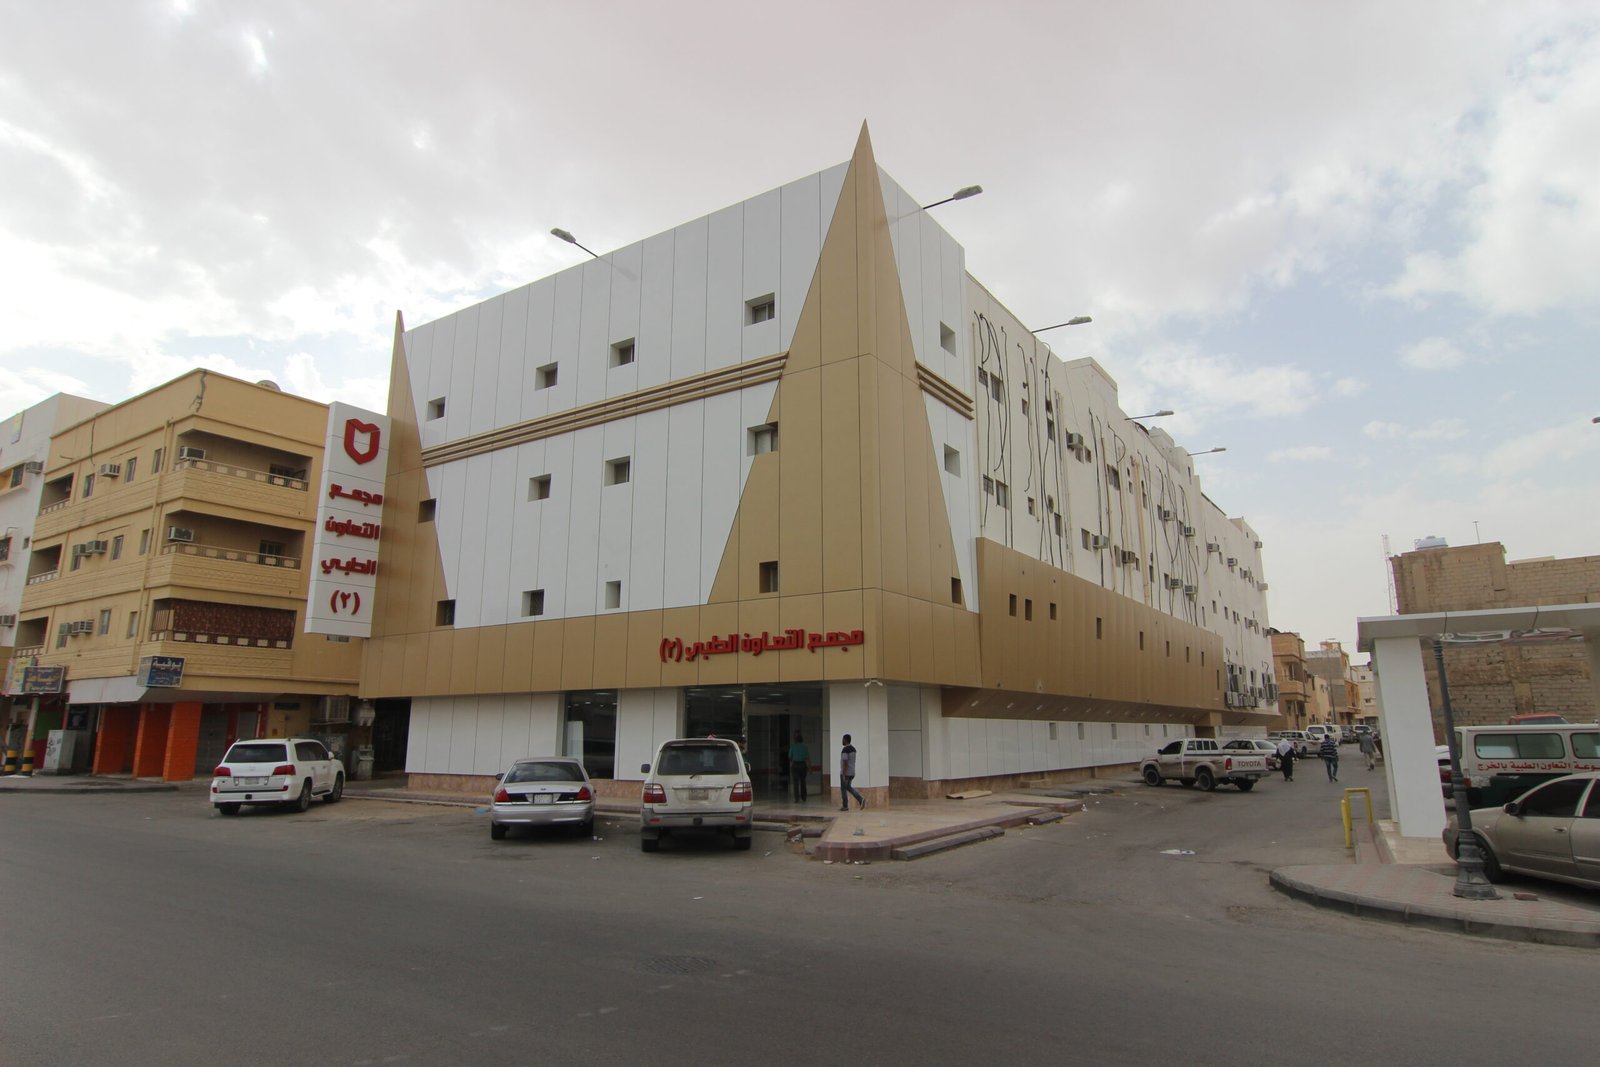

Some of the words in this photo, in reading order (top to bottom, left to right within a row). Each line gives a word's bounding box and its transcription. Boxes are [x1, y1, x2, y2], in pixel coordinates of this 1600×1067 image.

[329, 484, 383, 507] مجمع
[325, 515, 380, 539] التعاون
[321, 557, 377, 575] الطبي
[685, 634, 739, 662] الطبي
[741, 629, 805, 656] التعاون
[807, 630, 864, 653] مجمع
[1477, 761, 1508, 771] بالخرج
[1510, 761, 1540, 772] الطبية
[1541, 761, 1571, 771] التعاون
